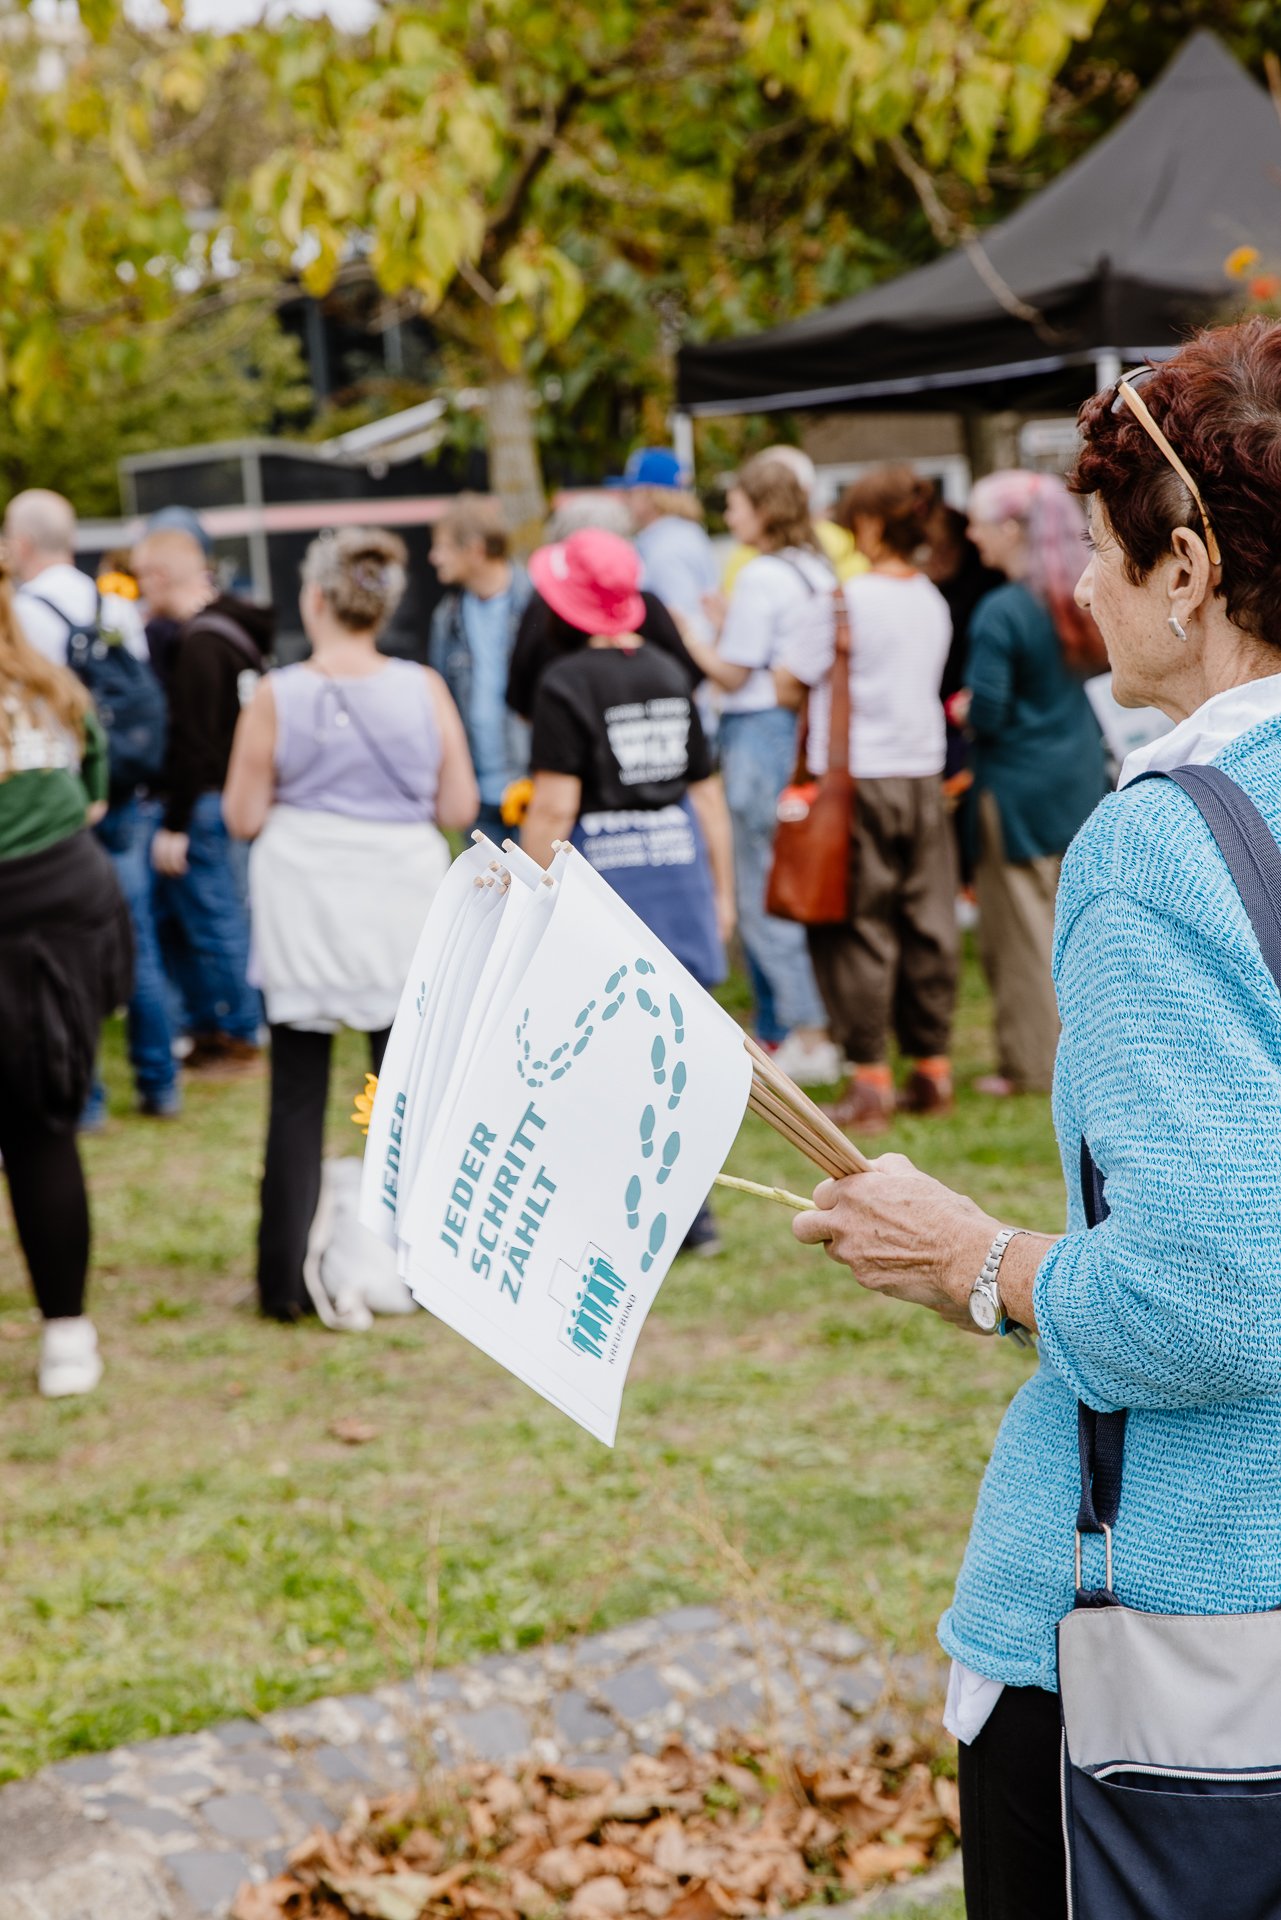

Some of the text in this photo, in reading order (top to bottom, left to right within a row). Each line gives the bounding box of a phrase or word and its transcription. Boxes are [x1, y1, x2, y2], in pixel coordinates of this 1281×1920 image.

[440, 1122, 497, 1258] JEDER
[471, 1101, 546, 1280] SCHRITT
[499, 1165, 557, 1304] ZÄHLT
[608, 1294, 636, 1364] KREUZBUND
